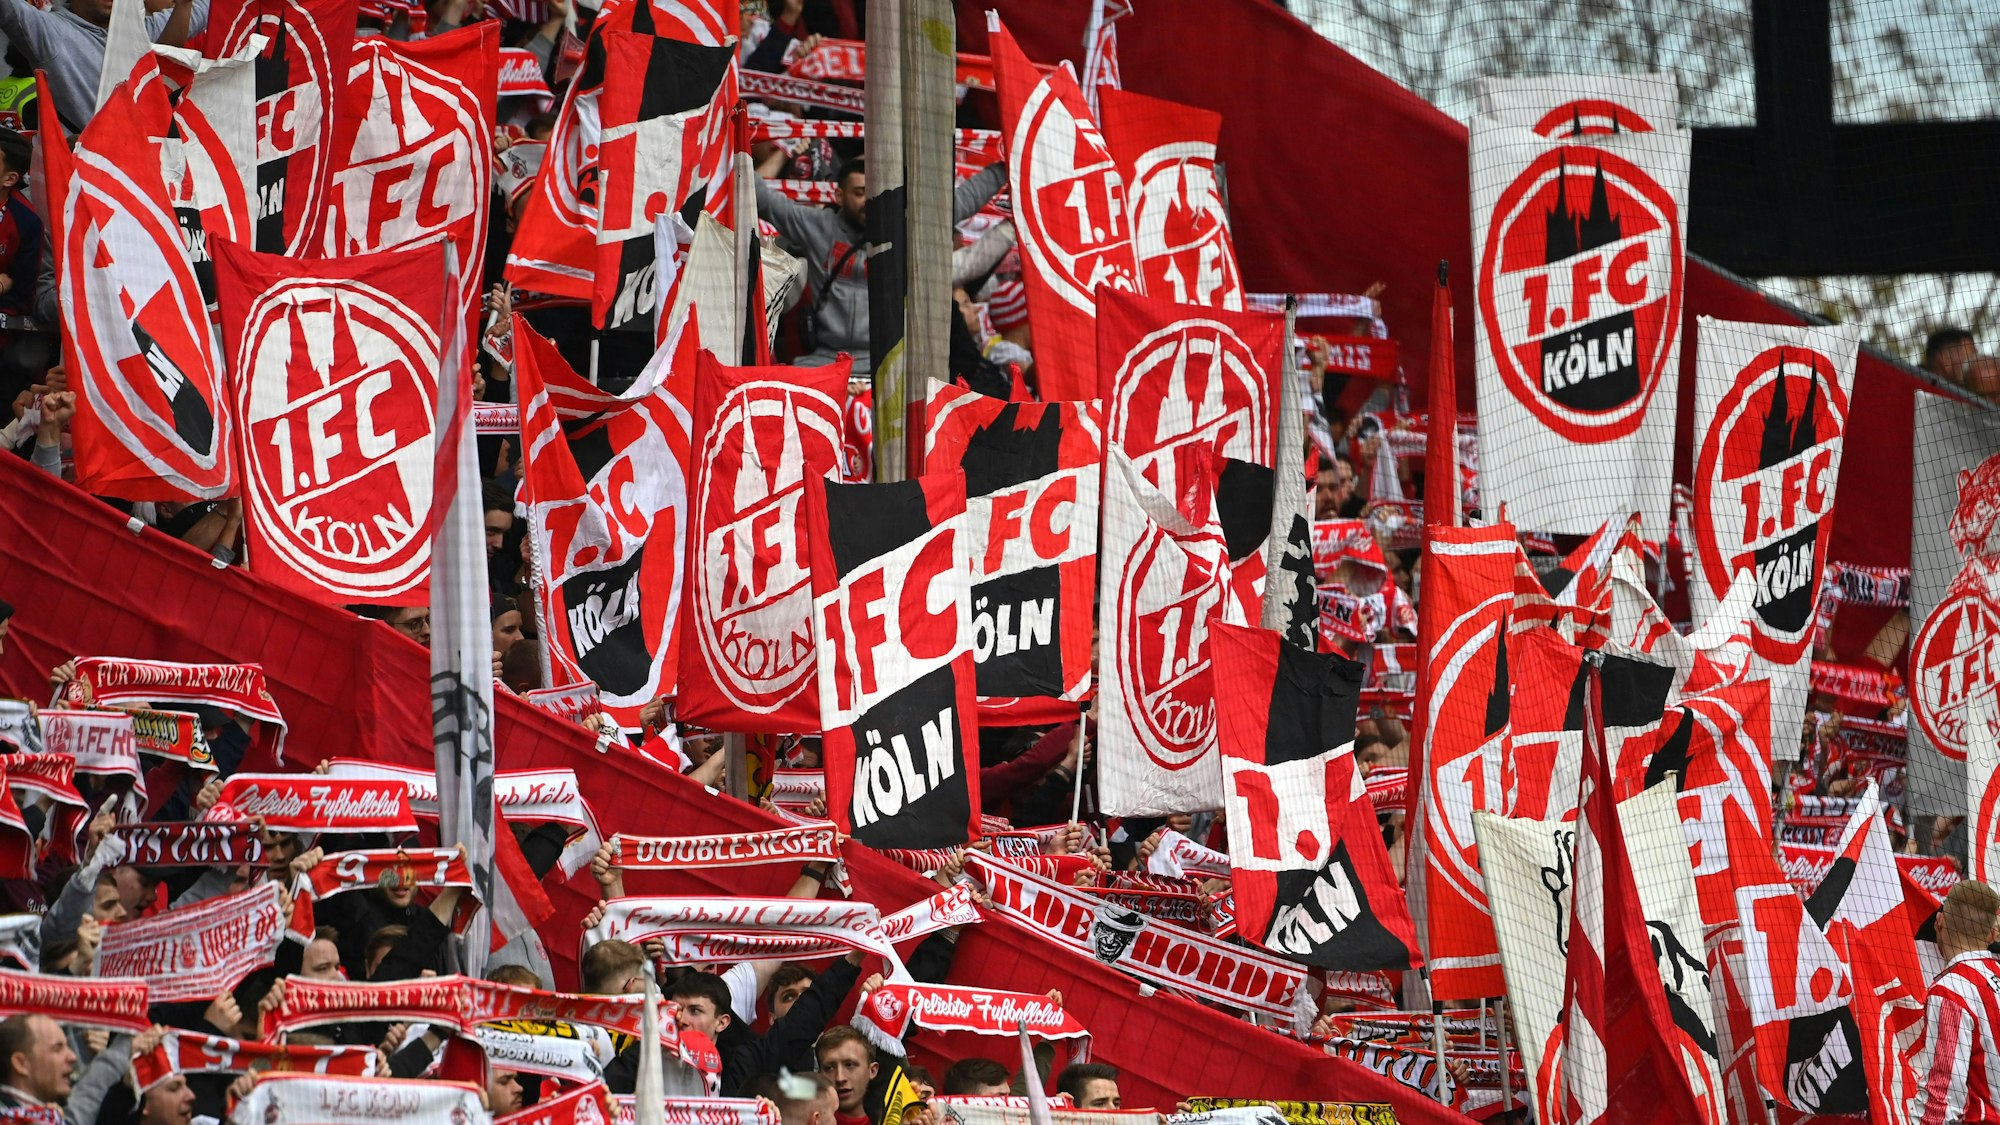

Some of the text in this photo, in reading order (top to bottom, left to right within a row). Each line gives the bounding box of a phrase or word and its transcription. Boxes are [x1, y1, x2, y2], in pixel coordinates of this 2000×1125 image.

[801, 46, 862, 78] SEI
[1065, 171, 1123, 244] 1.F
[1087, 255, 1138, 292] KÖ
[1163, 240, 1224, 307] 1.F
[1523, 241, 1649, 337] 1.FC
[1542, 326, 1634, 393] KÖLN
[270, 370, 397, 497] 1.FC
[1742, 448, 1832, 545] 1.FC
[298, 501, 415, 561] KÖLN
[1755, 540, 1816, 609] KÖLN
[568, 572, 641, 658] KÖLN
[721, 616, 815, 680] KÖLN
[973, 596, 1055, 664] ÖLN
[1158, 581, 1221, 685] 1.F
[77, 725, 111, 755] 1.FC
[853, 706, 956, 829] KÖLN
[233, 784, 308, 817] Geliebter
[310, 786, 404, 827] Fußballclub
[523, 781, 576, 806] Köln
[636, 830, 835, 863] DOUBLESIEGER
[624, 905, 751, 931] Fußball
[754, 906, 831, 928] Club
[1129, 930, 1302, 1008] HORDE
[907, 988, 1064, 1031] Geliebter Fußballclub
